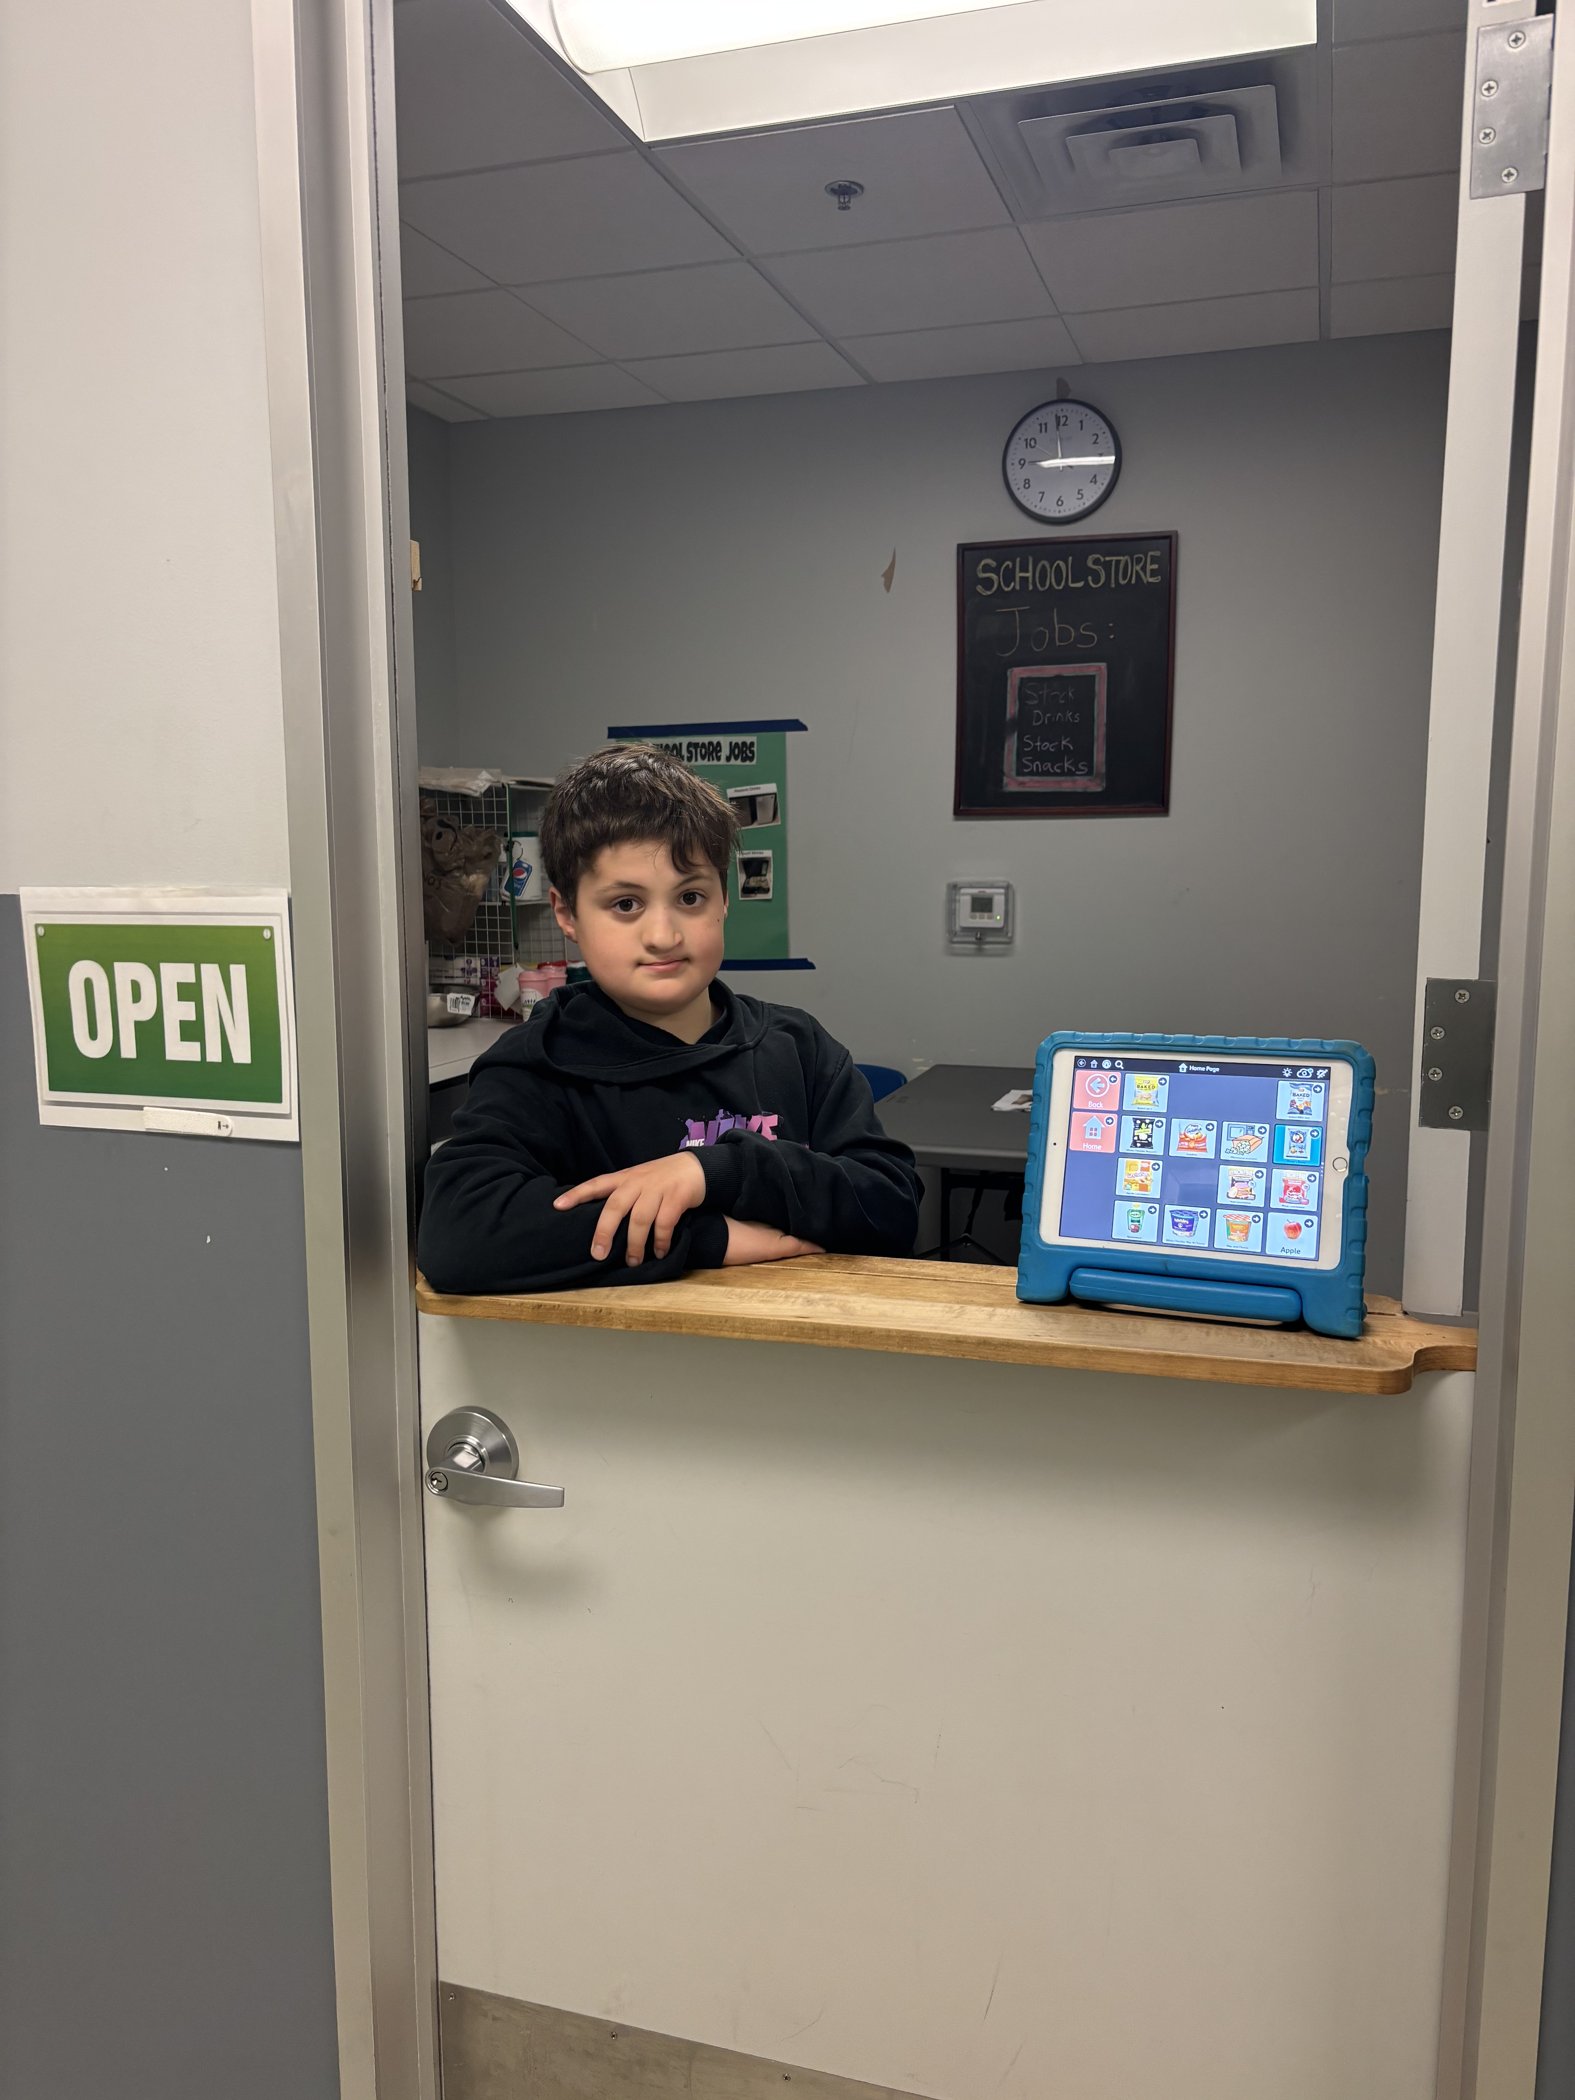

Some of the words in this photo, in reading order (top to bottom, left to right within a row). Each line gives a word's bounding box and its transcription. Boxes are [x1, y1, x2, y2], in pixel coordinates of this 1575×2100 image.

[1056, 414, 1069, 427] 12
[1079, 420, 1084, 431] 1
[1038, 422, 1048, 434] 11
[1024, 437, 1037, 449] 10
[1092, 433, 1099, 445] 2
[1018, 458, 1026, 469] 9
[1023, 478, 1031, 489] 8
[1089, 474, 1098, 485] 4
[1038, 491, 1045, 503] 7
[1076, 489, 1084, 500] 5
[1056, 495, 1064, 507] 6
[976, 556, 1084, 596] SCHOOL
[1086, 551, 1161, 588] STORE
[1032, 710, 1080, 726] Drinks
[1023, 735, 1073, 752] Stock
[725, 741, 755, 763] JOBS
[1022, 755, 1088, 774] Snacks
[68, 960, 252, 1064] OPEN
[1088, 1100, 1104, 1109] Back
[1082, 1142, 1102, 1150] Home
[1280, 1246, 1301, 1255] Apple
